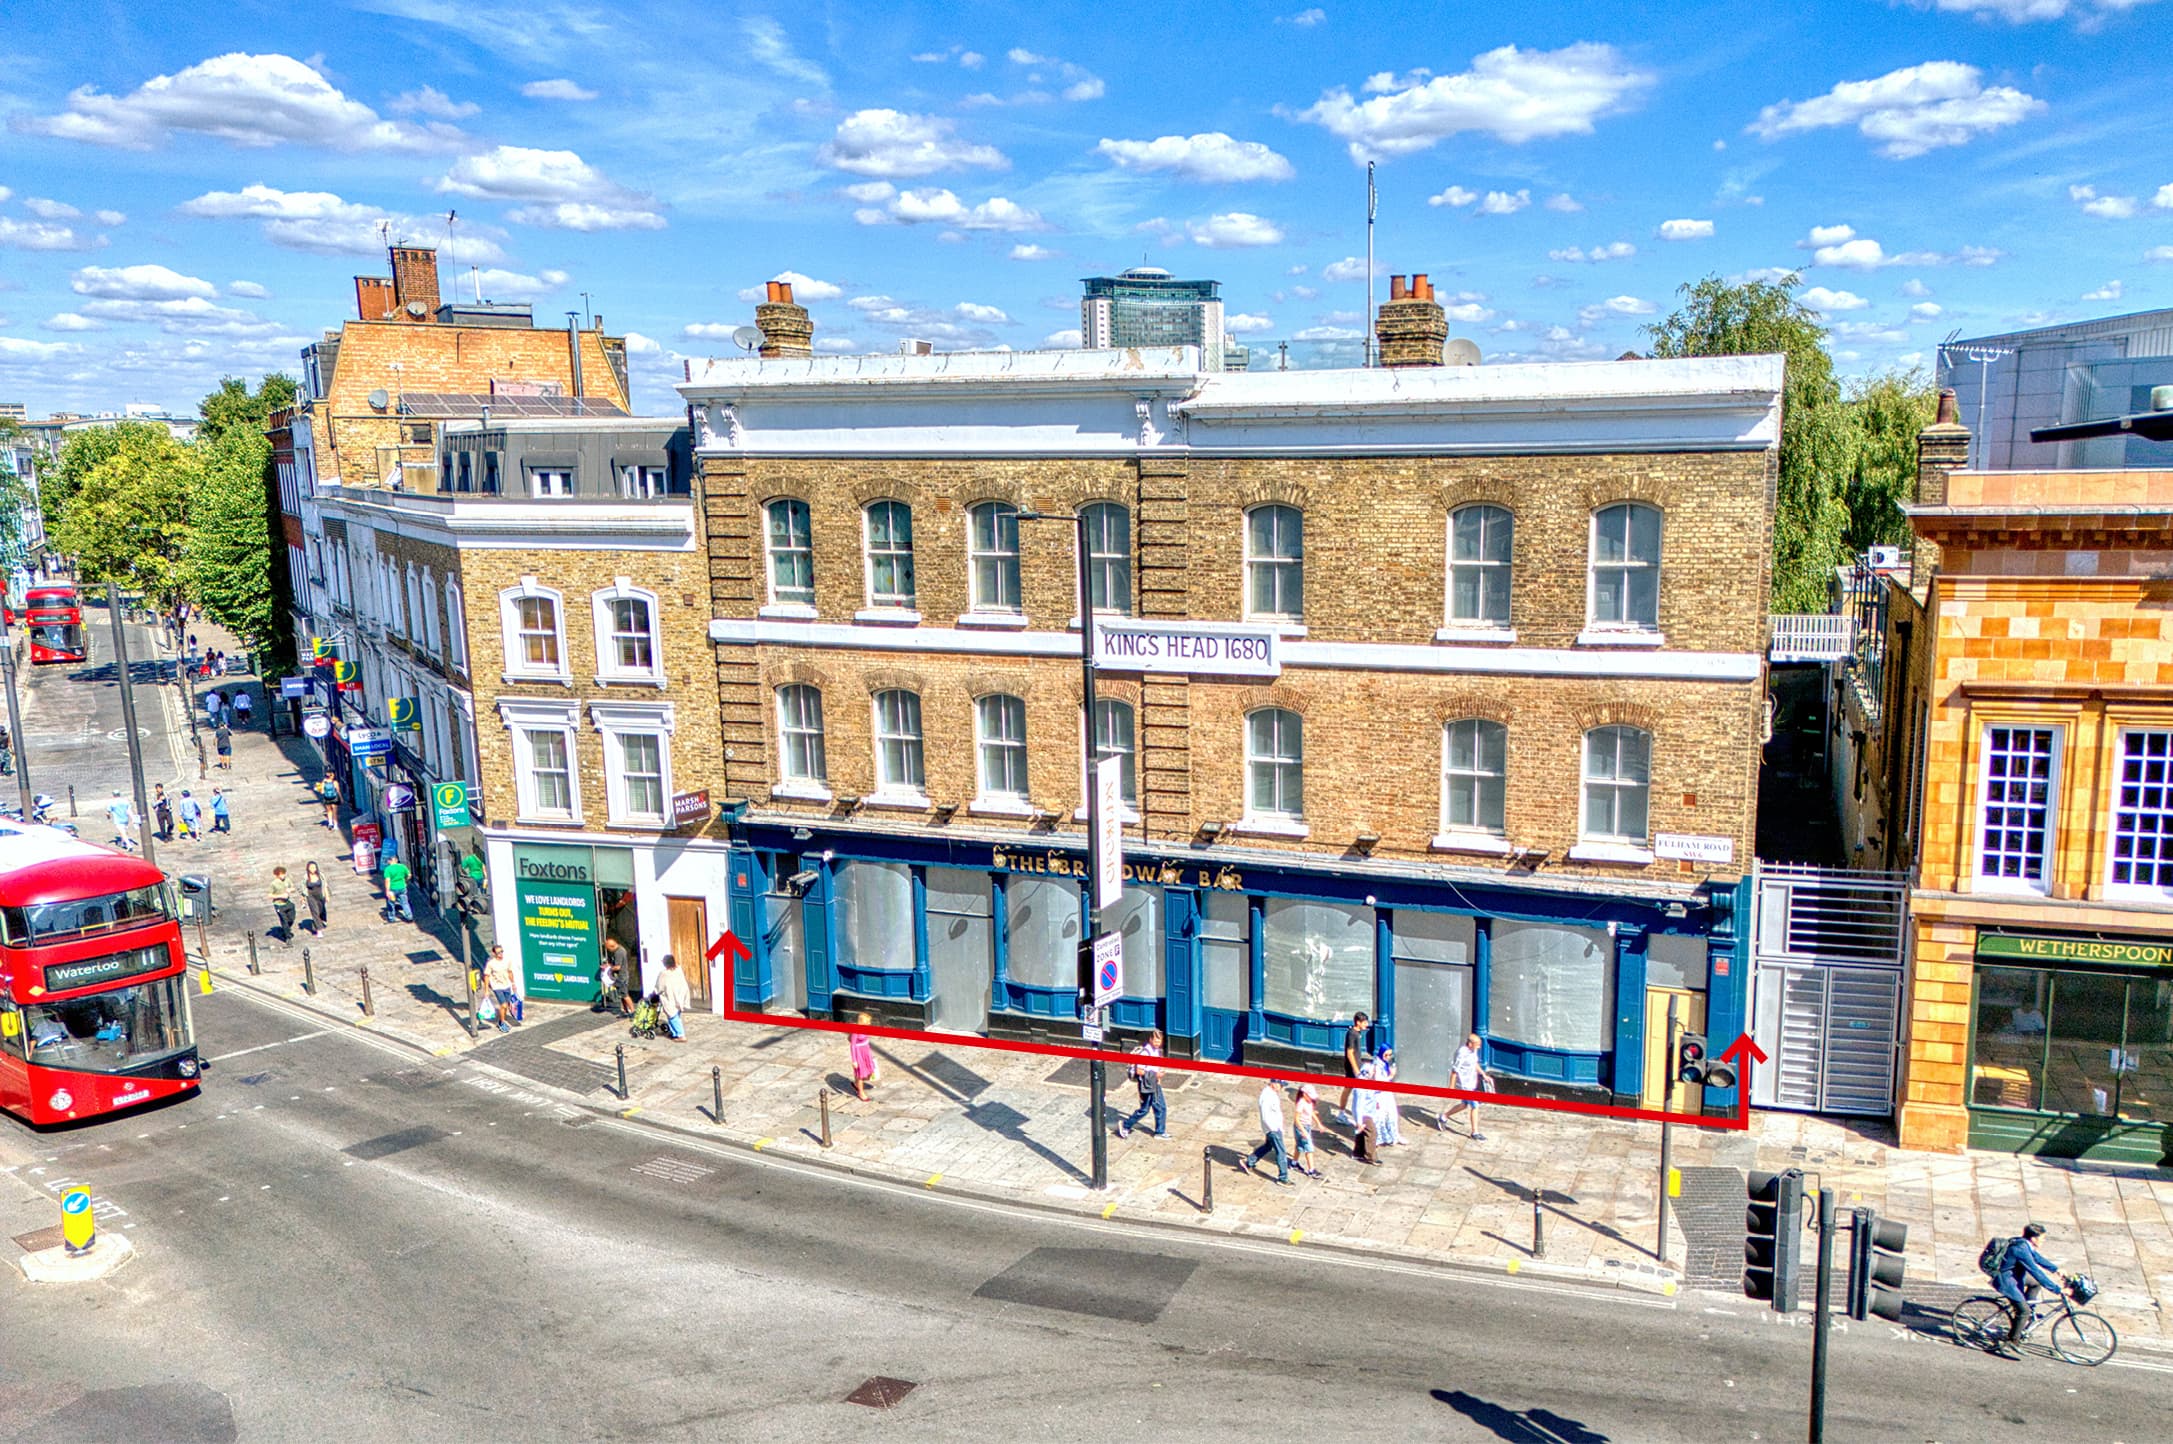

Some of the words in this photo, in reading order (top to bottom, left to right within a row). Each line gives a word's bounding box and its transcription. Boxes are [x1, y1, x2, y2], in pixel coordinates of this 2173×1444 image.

[1166, 635, 1218, 659] HEAD
[1224, 638, 1268, 660] 1680
[674, 795, 699, 807] MARSH
[675, 801, 708, 815] PARSONS
[439, 807, 465, 816] Foxtons
[1658, 839, 1700, 849] FULHAM
[1703, 843, 1731, 851] ROAD
[519, 857, 588, 880] Foxtons
[1007, 854, 1044, 873] THE
[1059, 857, 1184, 885] BRDWAY
[1199, 871, 1243, 890] BAR
[524, 894, 536, 904] WE
[536, 895, 551, 905] LOVE
[550, 896, 587, 908] LANDLORDS
[2019, 938, 2172, 963] WETHERSPOON
[55, 960, 120, 980] Waterloo
